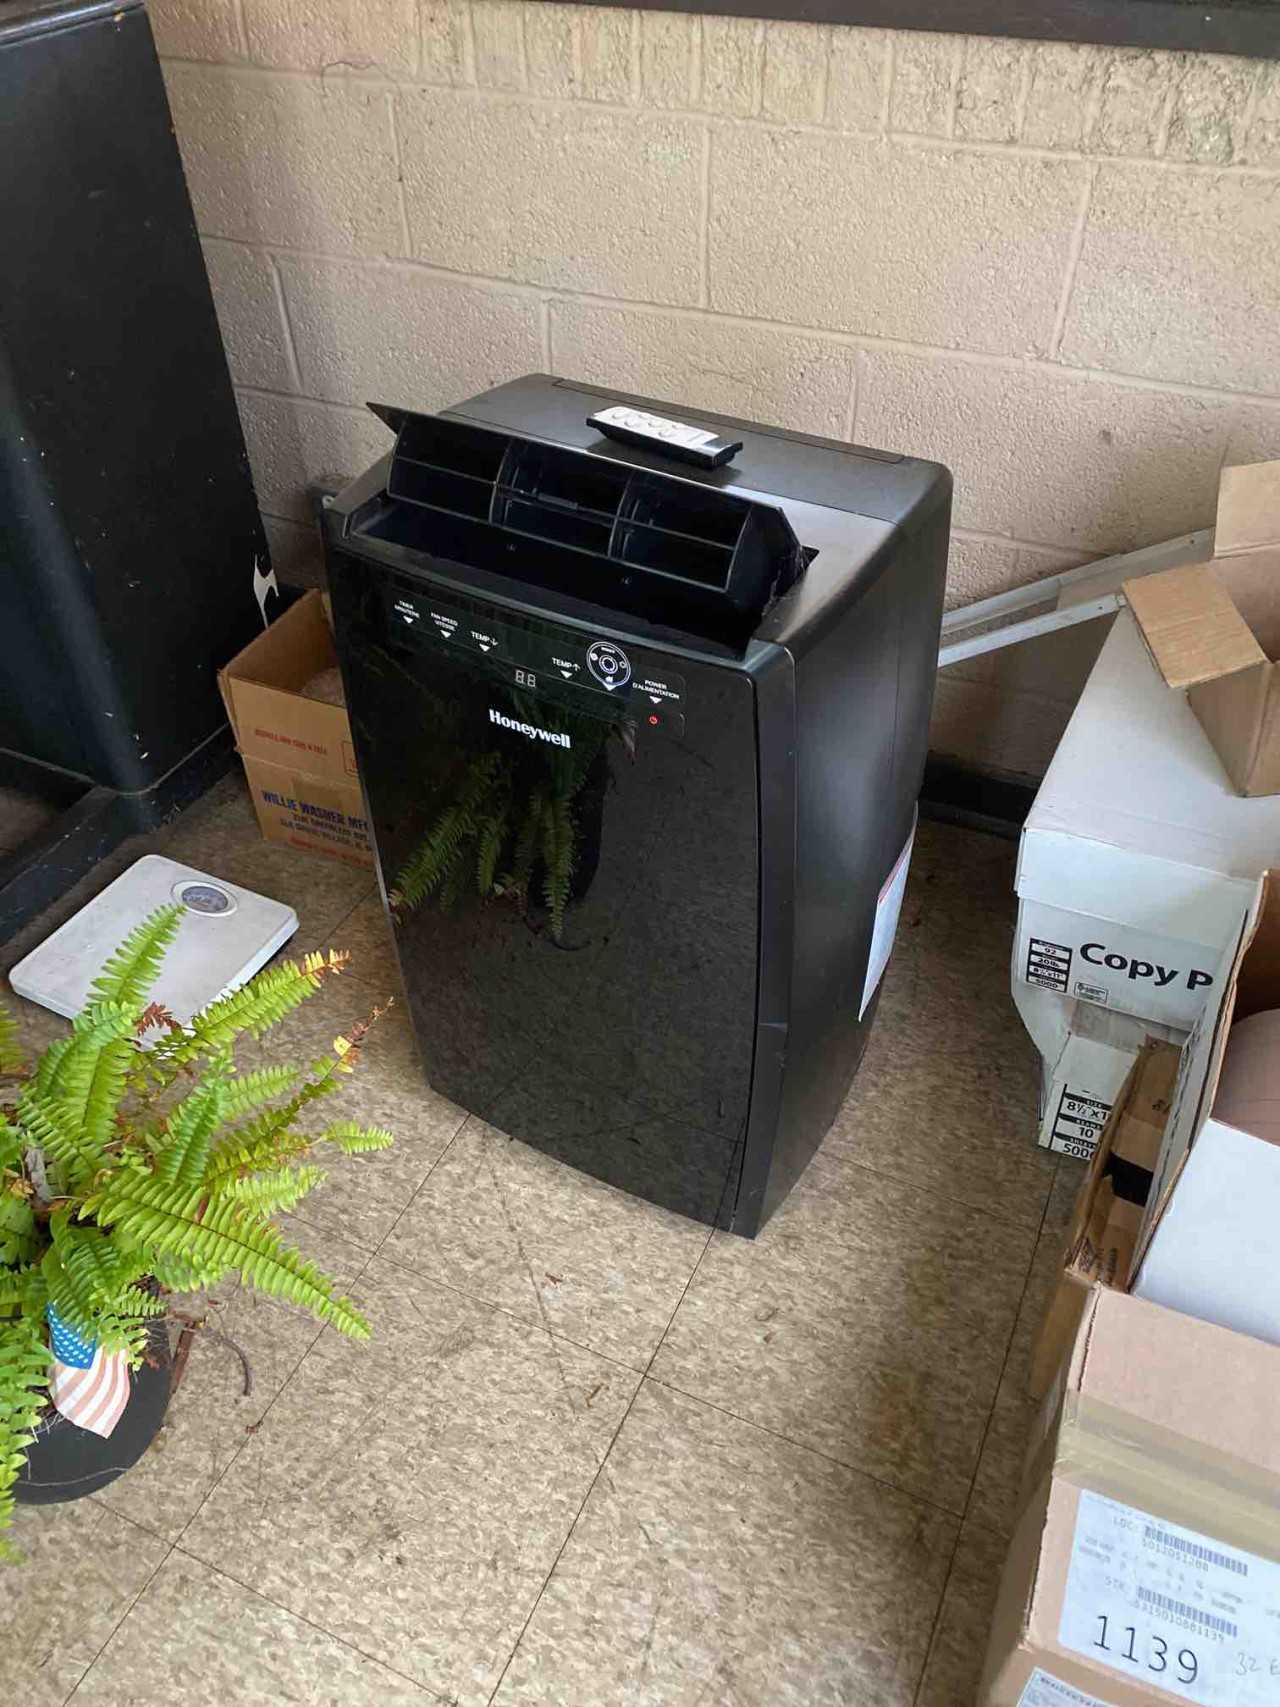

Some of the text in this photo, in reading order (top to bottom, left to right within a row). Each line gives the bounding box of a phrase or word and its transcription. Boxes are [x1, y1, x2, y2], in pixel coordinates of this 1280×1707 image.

[644, 679, 667, 690] POWER
[488, 708, 571, 748] Honeywell
[1080, 943, 1179, 987] Copy
[1079, 1127, 1094, 1139] 10
[1093, 1615, 1199, 1685] 1139
[1235, 1651, 1262, 1677] 32
